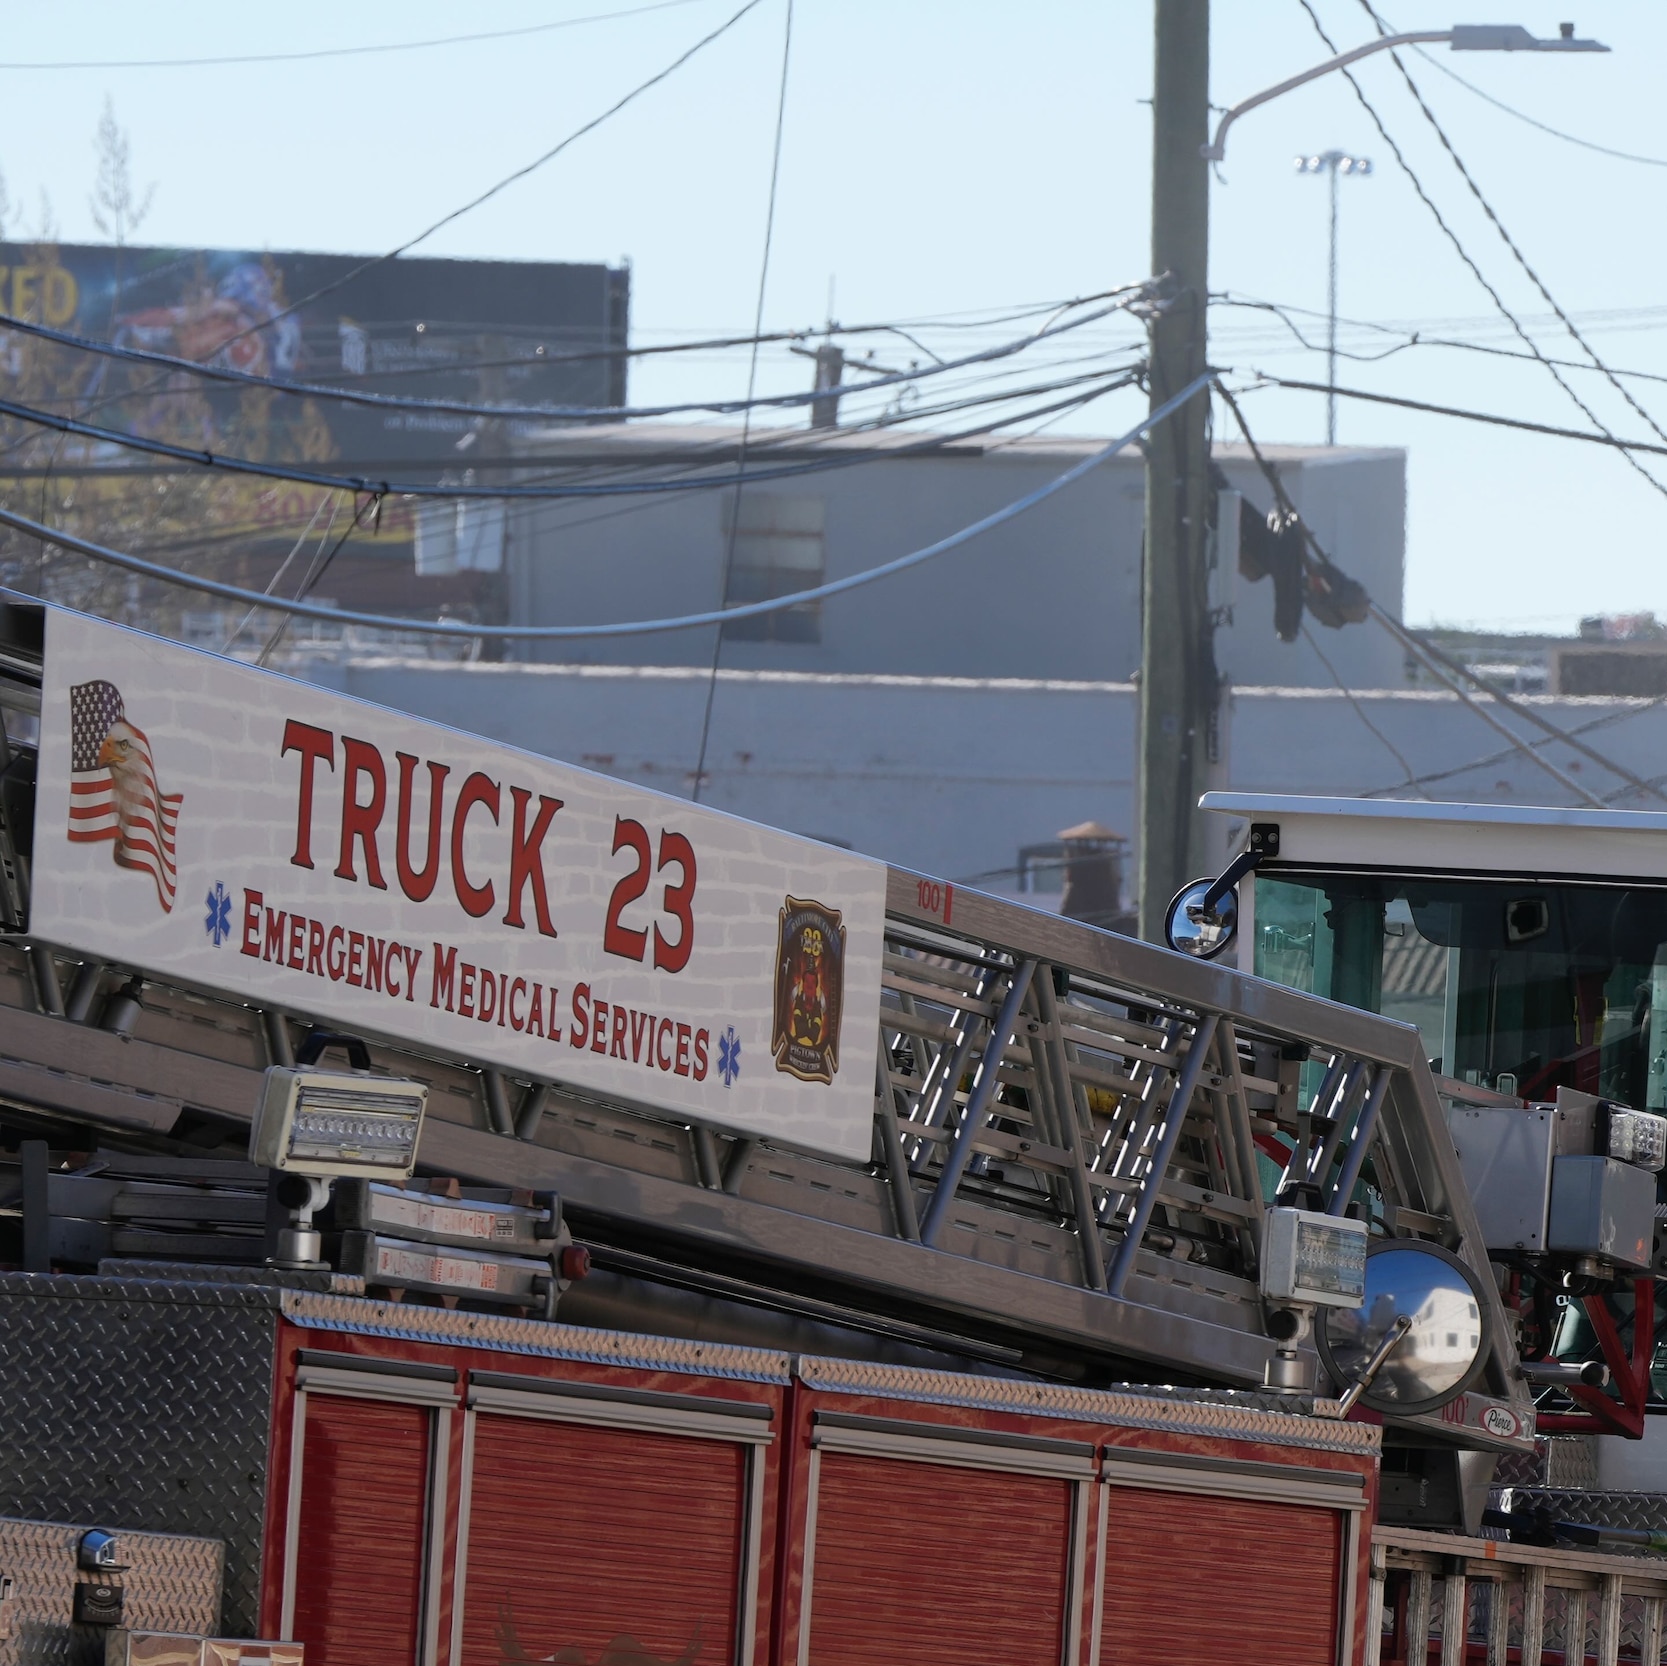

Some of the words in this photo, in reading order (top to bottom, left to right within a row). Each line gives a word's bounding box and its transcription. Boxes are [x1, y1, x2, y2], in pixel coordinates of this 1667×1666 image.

[281, 718, 565, 938] TRUCK
[603, 813, 697, 974] 23
[1487, 1409, 1512, 1431] Pierce
